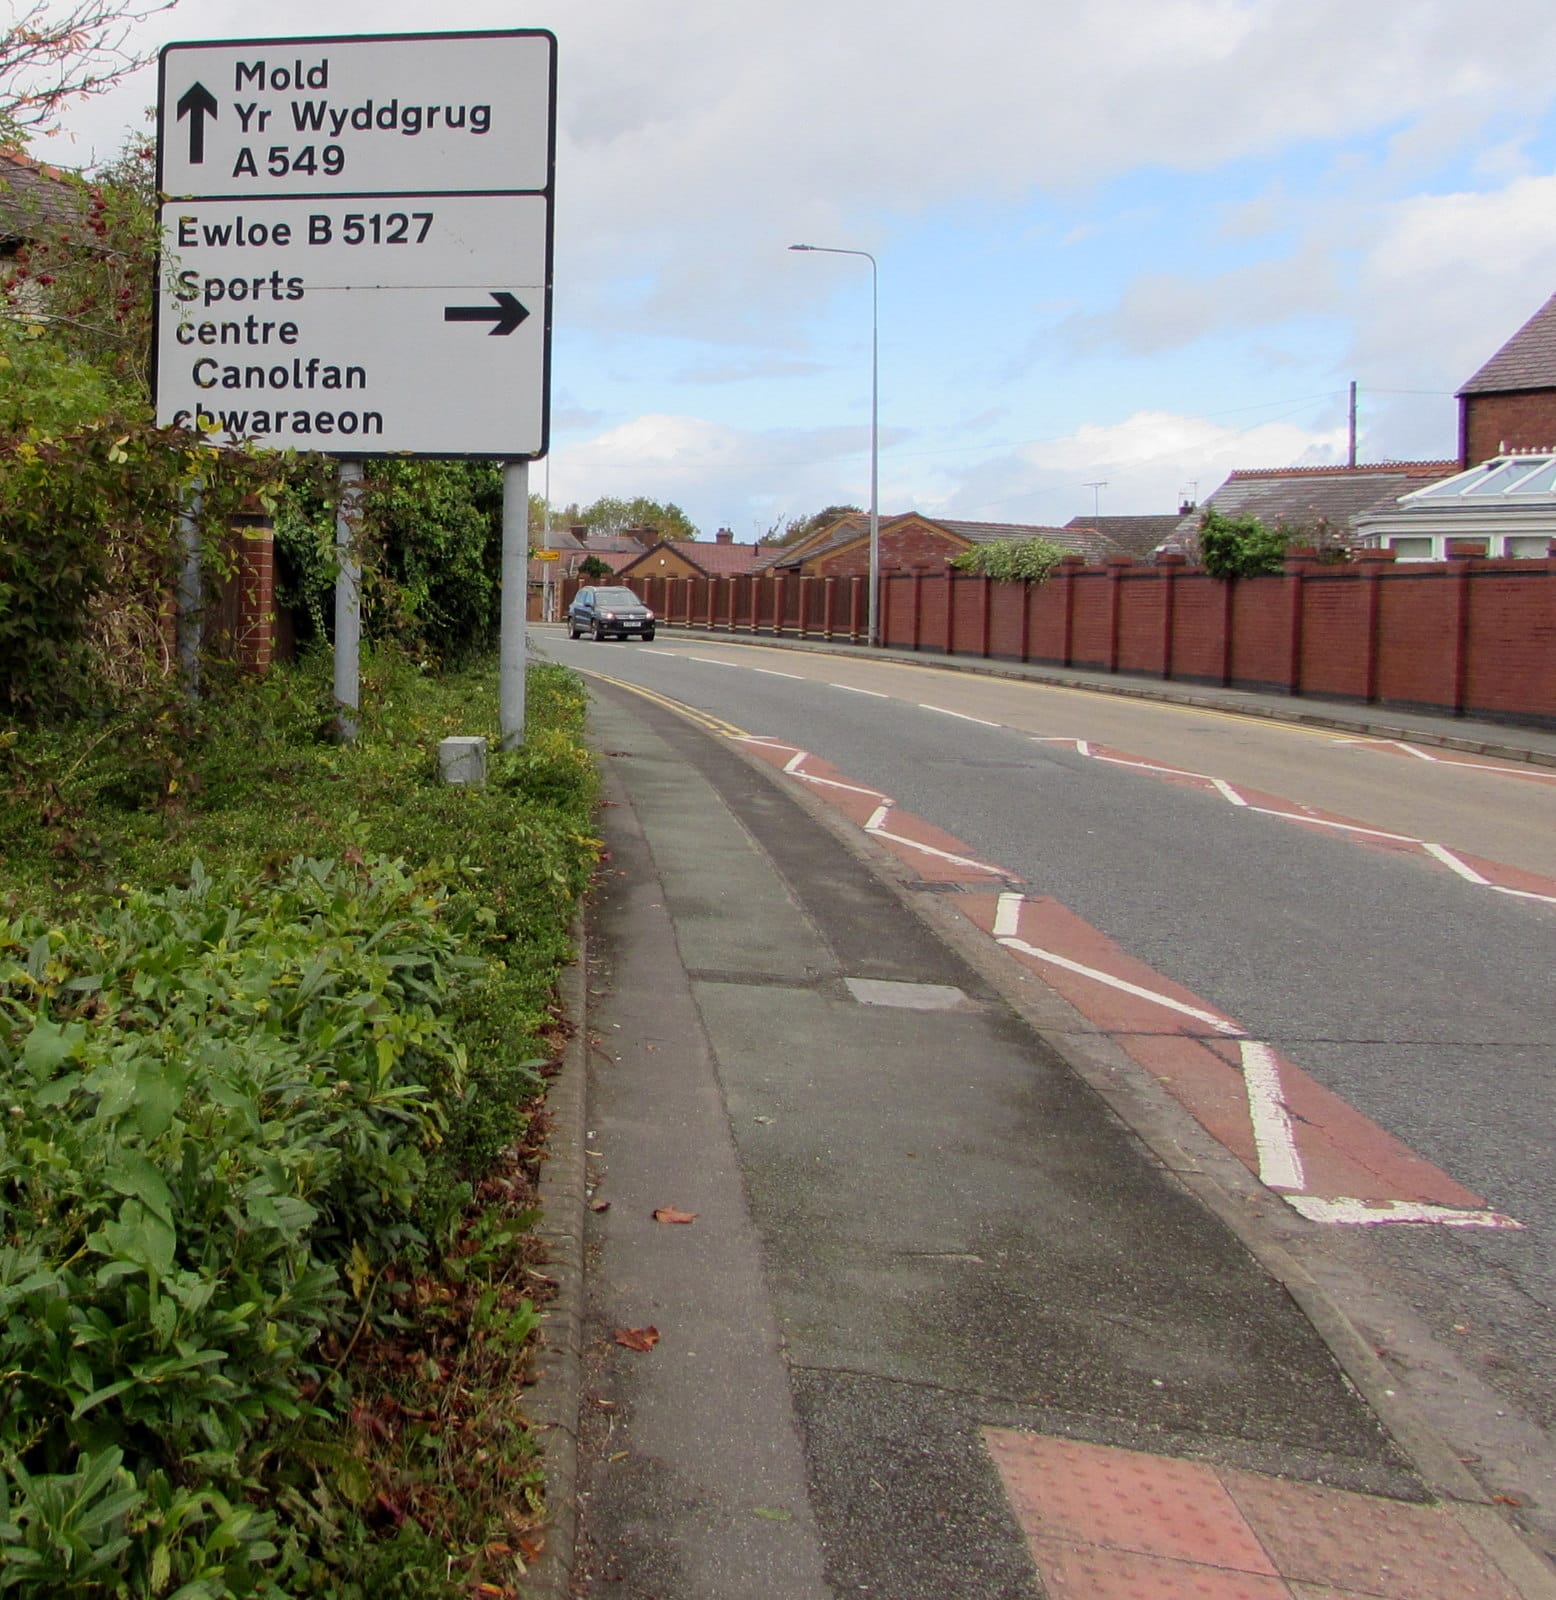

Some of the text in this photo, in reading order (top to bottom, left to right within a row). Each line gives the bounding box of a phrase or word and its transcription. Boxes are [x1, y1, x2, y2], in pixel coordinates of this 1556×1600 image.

[235, 57, 329, 92] Mold
[233, 98, 491, 138] Yr Wyddgrug
[177, 215, 292, 248] Ewloe
[175, 270, 305, 307] Sports
[175, 314, 299, 346] centre
[192, 356, 366, 390] Canolfan
